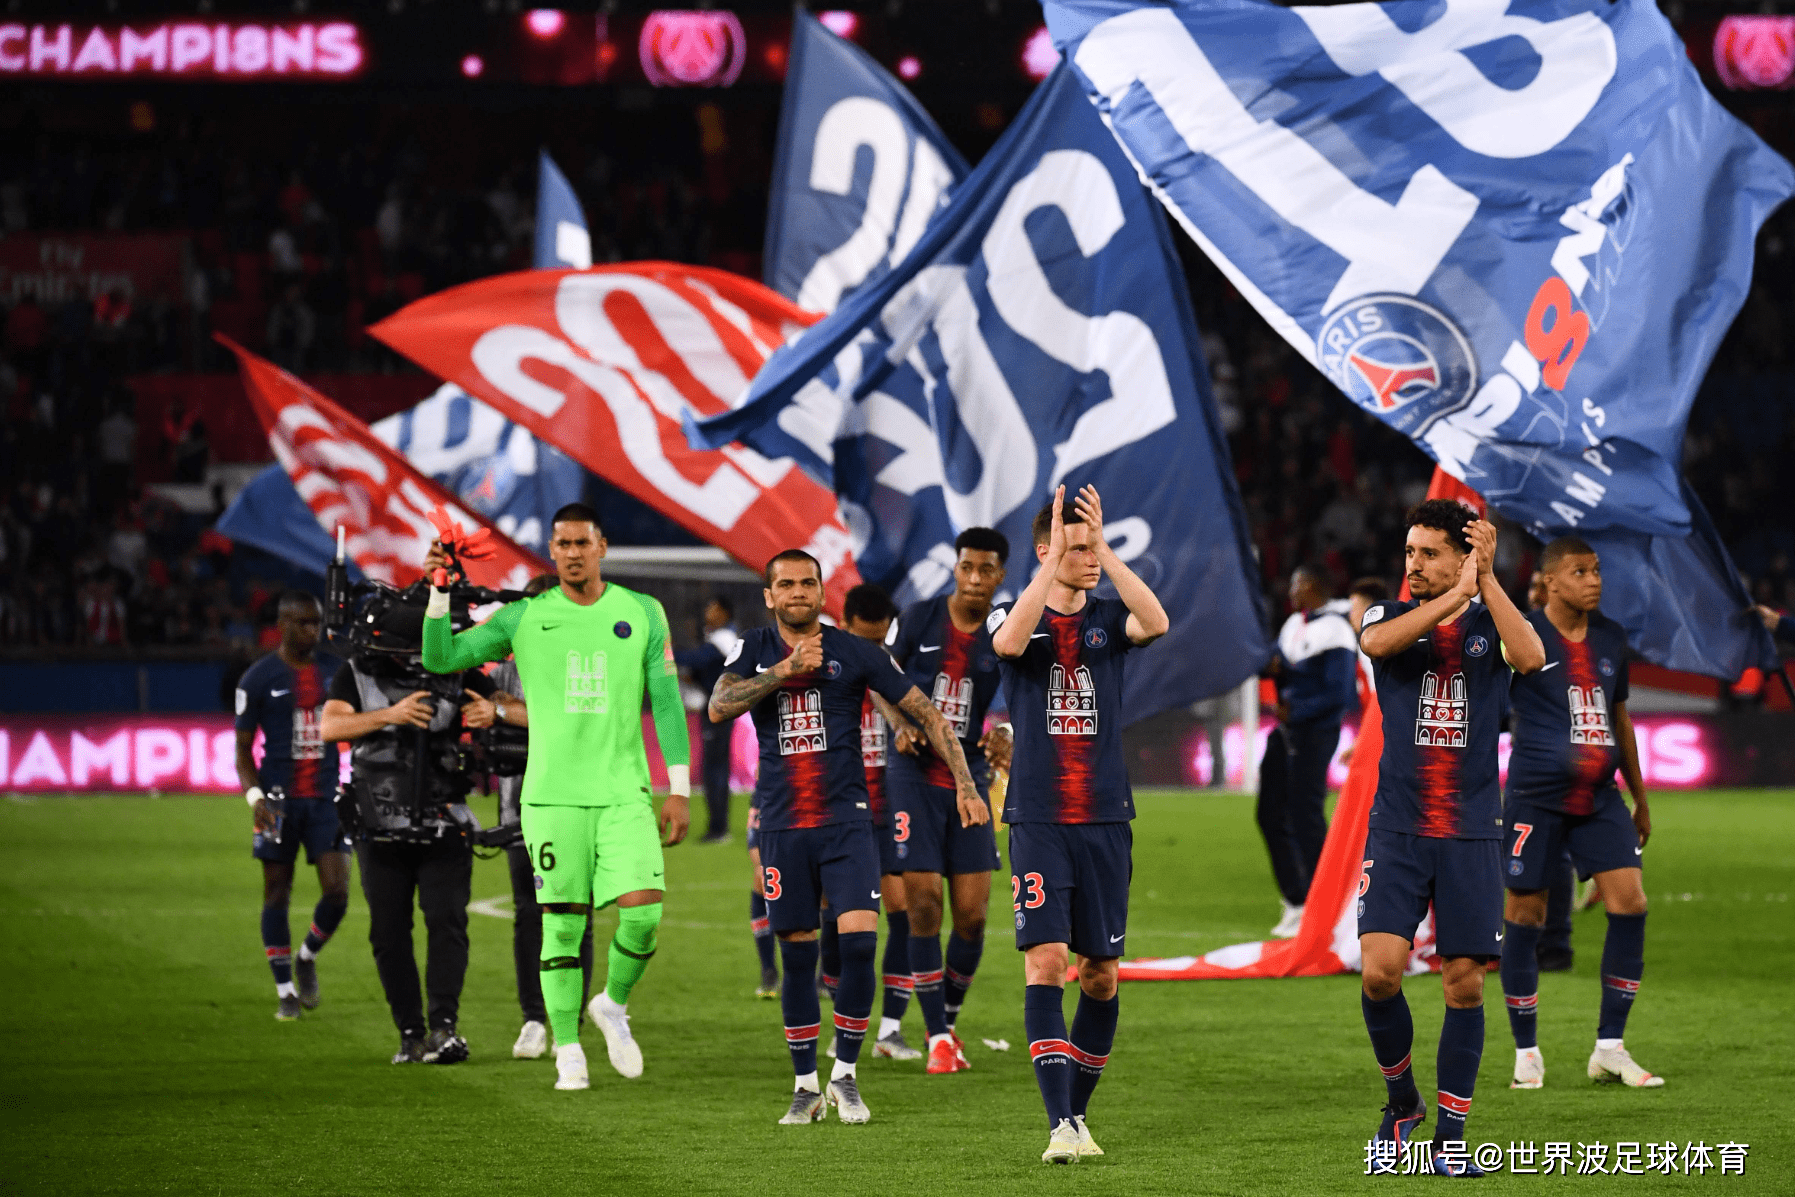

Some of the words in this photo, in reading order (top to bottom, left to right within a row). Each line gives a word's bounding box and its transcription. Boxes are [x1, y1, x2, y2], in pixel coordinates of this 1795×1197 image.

[0, 22, 362, 74] CHAMPI8NS
[893, 810, 911, 843] 3
[1511, 822, 1534, 857] 7
[760, 866, 783, 901] 3
[1010, 871, 1046, 912] 23
